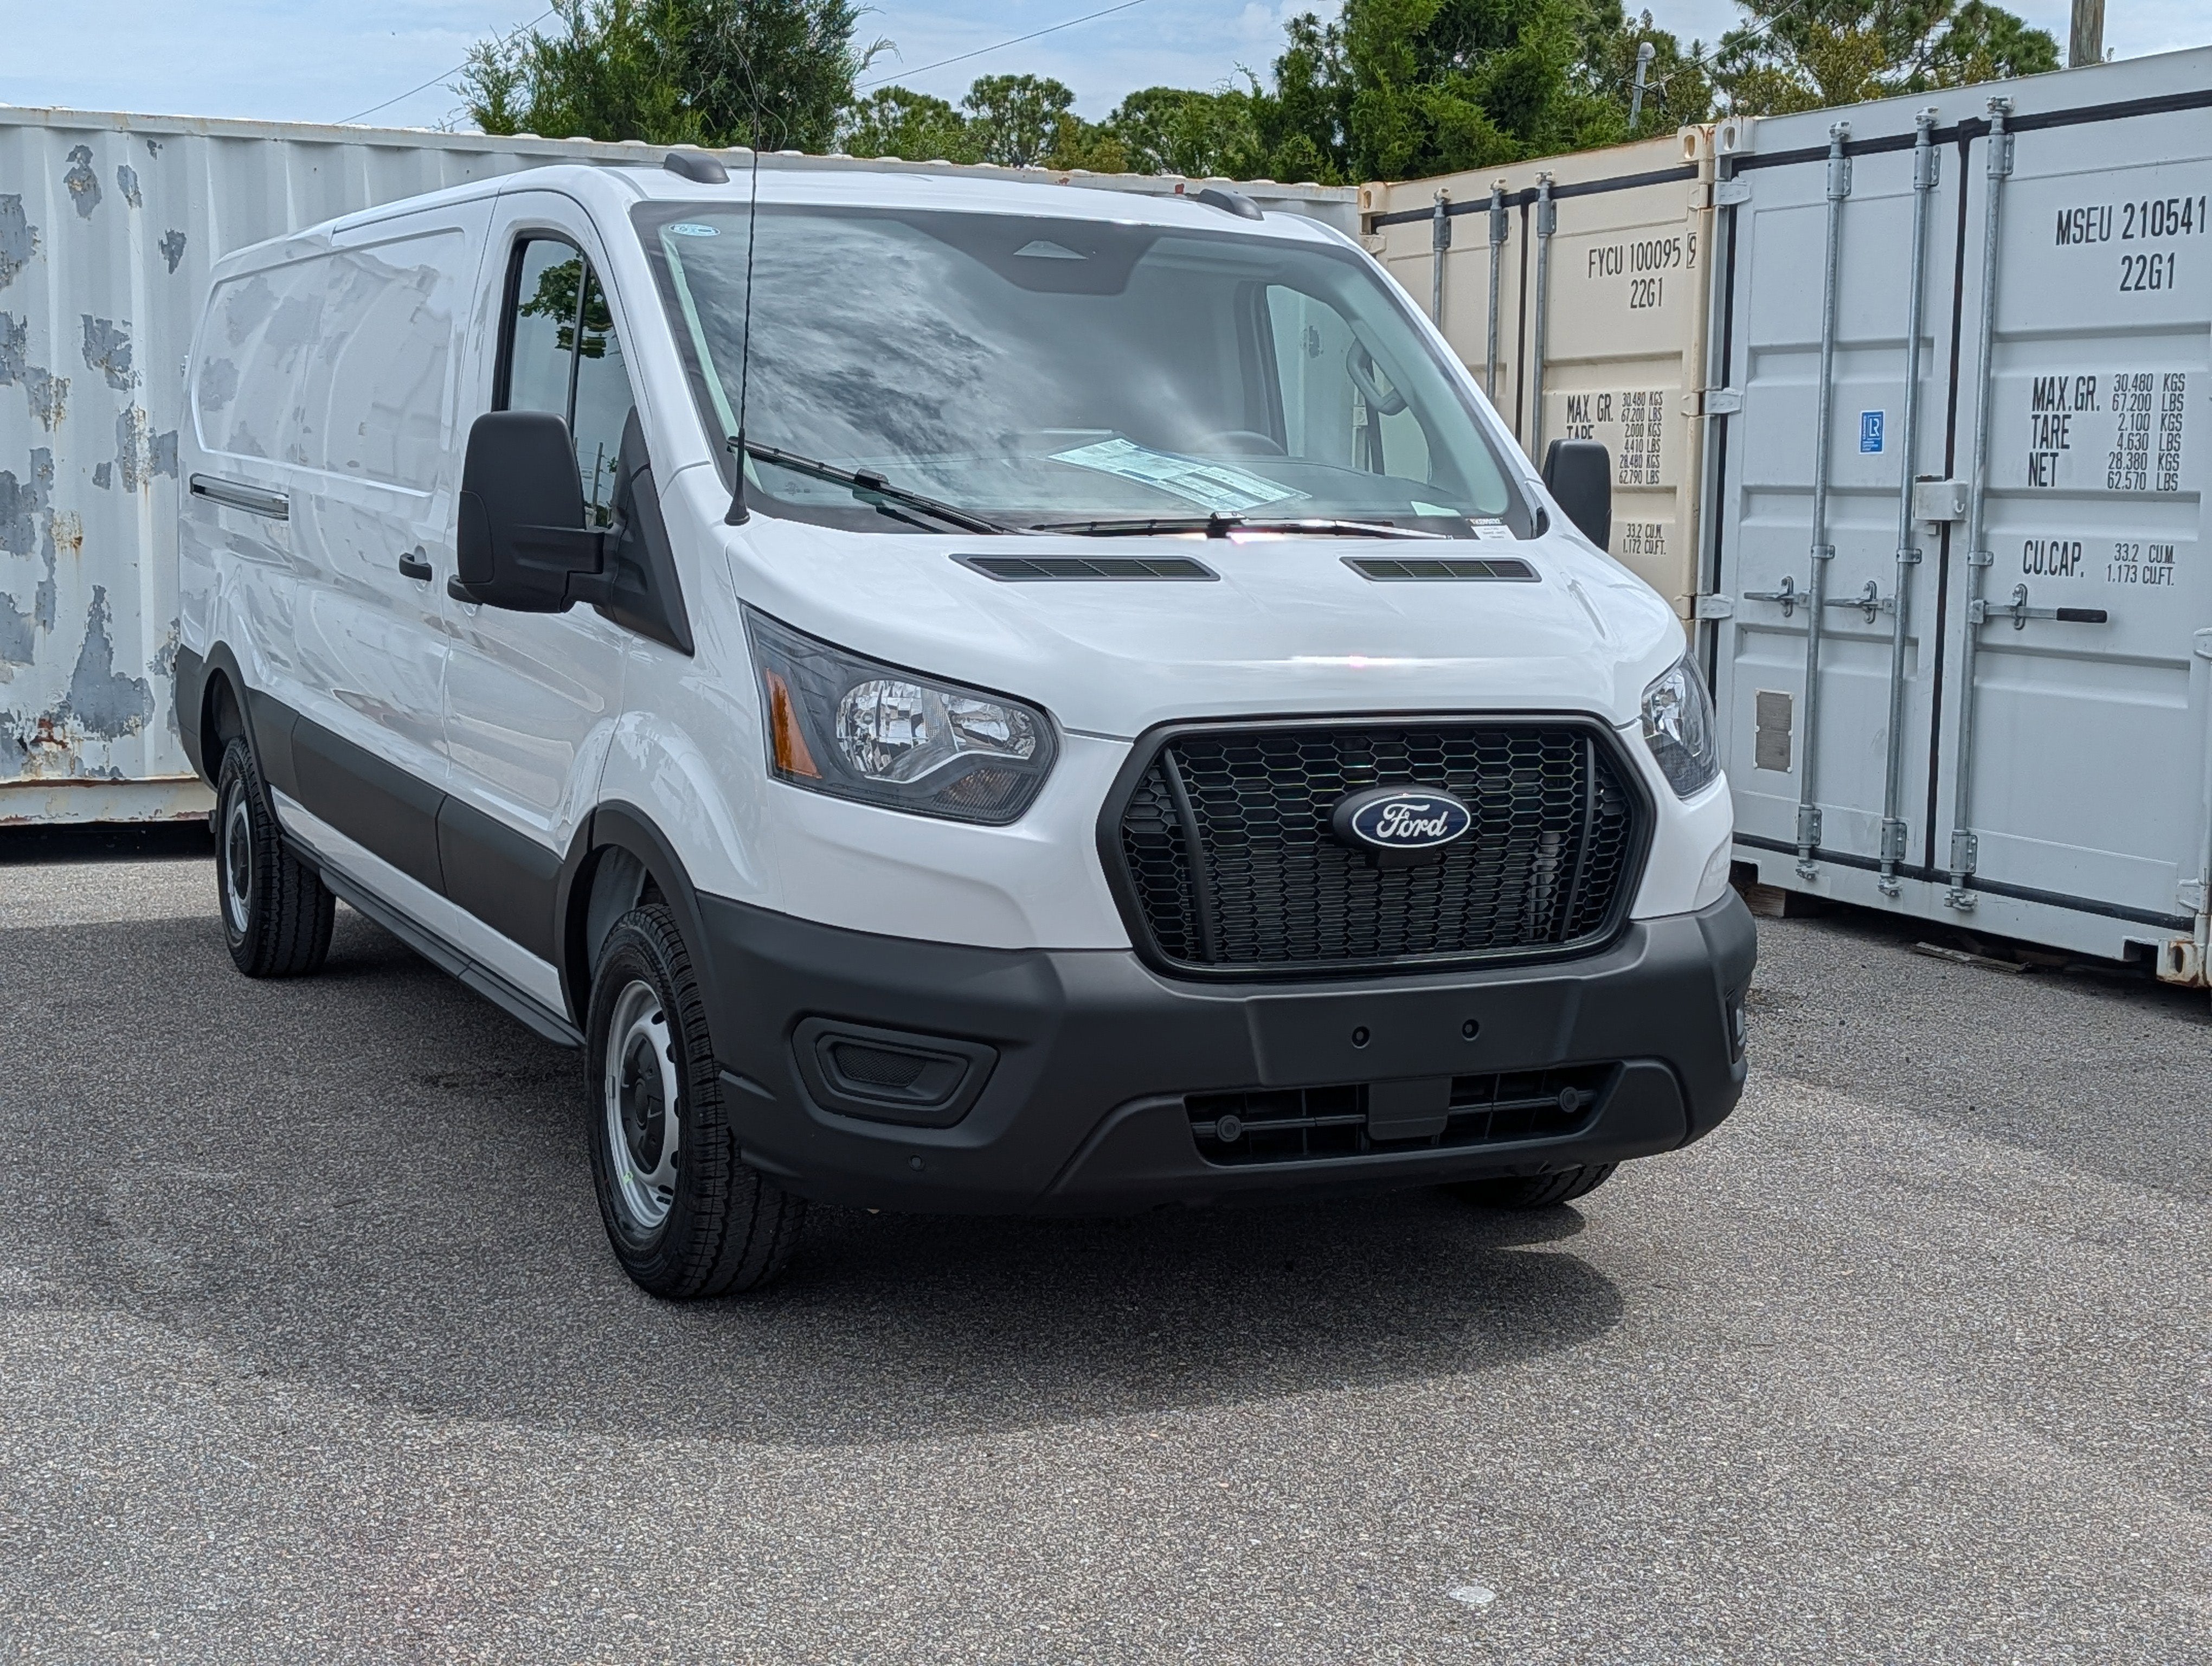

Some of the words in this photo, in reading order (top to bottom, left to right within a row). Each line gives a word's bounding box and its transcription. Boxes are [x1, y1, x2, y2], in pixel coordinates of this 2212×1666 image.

[2055, 205, 2113, 246] MSEU
[2121, 195, 2207, 240] 210541
[1588, 245, 1623, 279] FYCU
[1630, 236, 1681, 272] 100095
[1688, 235, 1696, 266] 9
[2119, 252, 2175, 292] 22G1
[1630, 277, 1663, 309] 22G1
[2163, 373, 2185, 392] KGS
[1567, 394, 1591, 424] MAX.
[1597, 393, 1613, 422] GR.
[1649, 391, 1663, 406] KGS
[1648, 407, 1662, 422] LBS
[2161, 393, 2184, 412] LBS
[1647, 422, 1662, 438] KGS
[2031, 414, 2072, 450] TARE
[2118, 413, 2151, 432] 2.100
[2159, 413, 2183, 432] KGS
[2158, 433, 2182, 452] LBS
[1647, 438, 1661, 453] LBS
[1646, 454, 1660, 469] KGS
[2028, 452, 2059, 488] NET
[2157, 452, 2180, 472] KGS
[1645, 470, 1660, 485] LBS
[2156, 472, 2178, 491] LBS
[2023, 540, 2084, 578] CU.CAP.
[2114, 543, 2139, 562] 33.2
[1376, 804, 1449, 838] Ford
